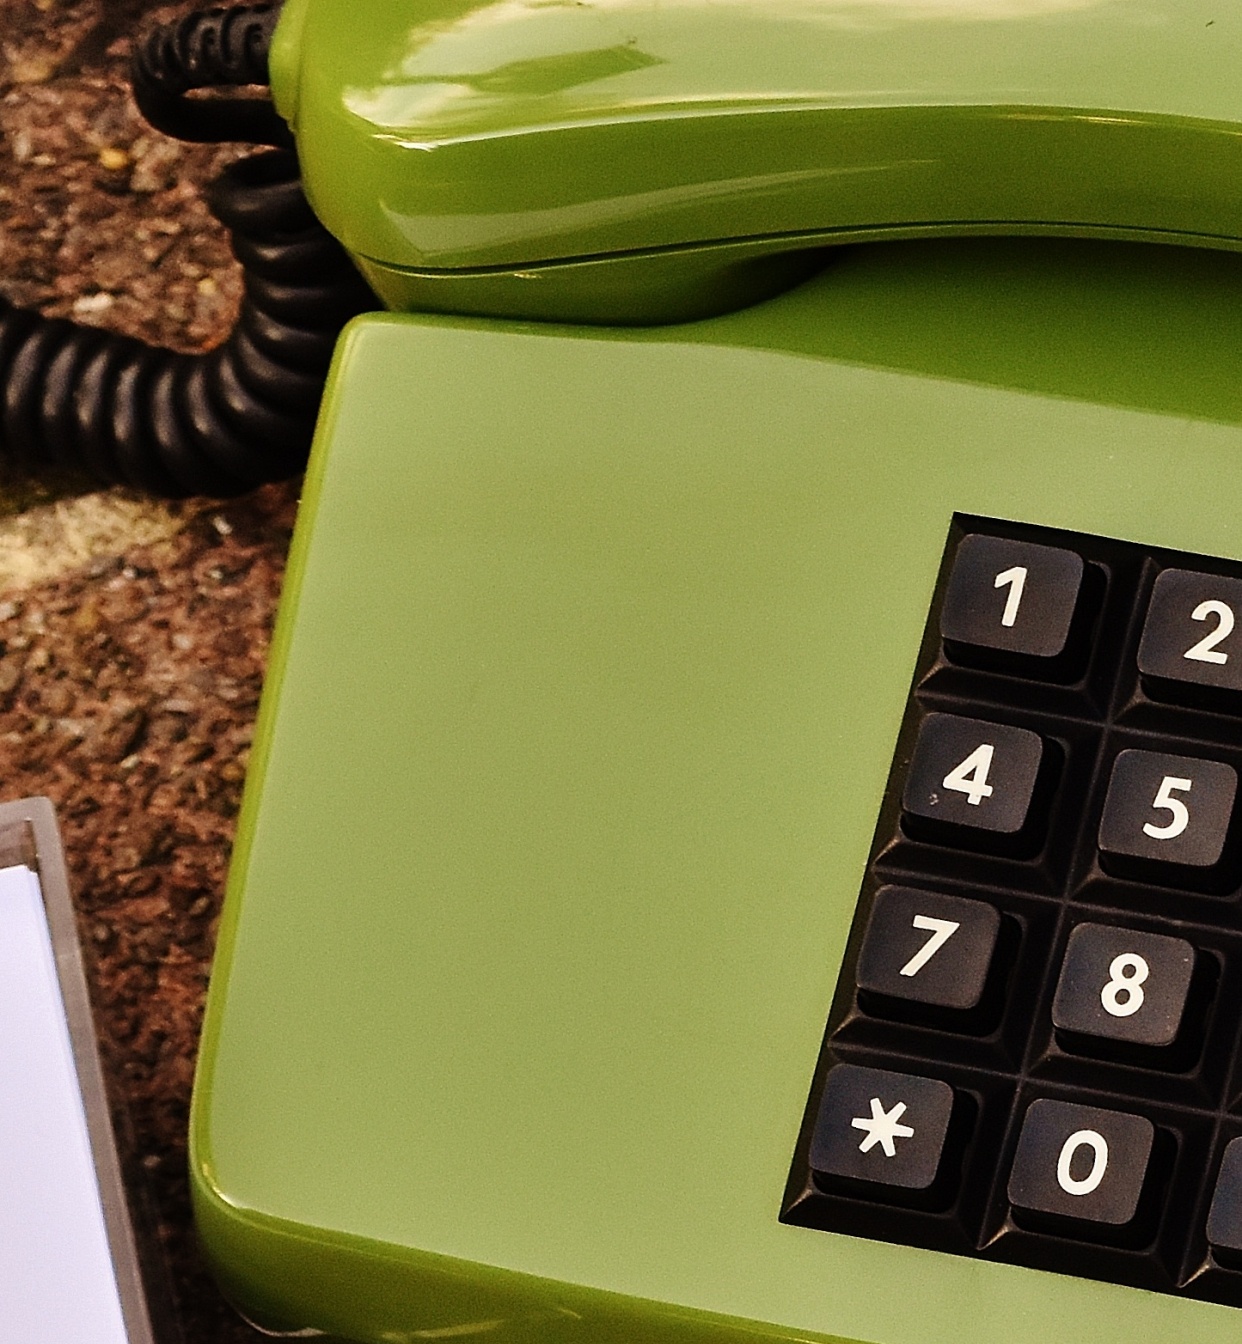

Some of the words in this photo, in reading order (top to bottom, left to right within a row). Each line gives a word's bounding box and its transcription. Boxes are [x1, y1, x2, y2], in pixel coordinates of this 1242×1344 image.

[993, 566, 1028, 627] 1
[1183, 599, 1235, 665] 2
[942, 743, 995, 806] 4
[1142, 776, 1192, 840] 5
[899, 914, 961, 977] 7
[1100, 952, 1150, 1017] 8
[1056, 1129, 1109, 1196] 0
